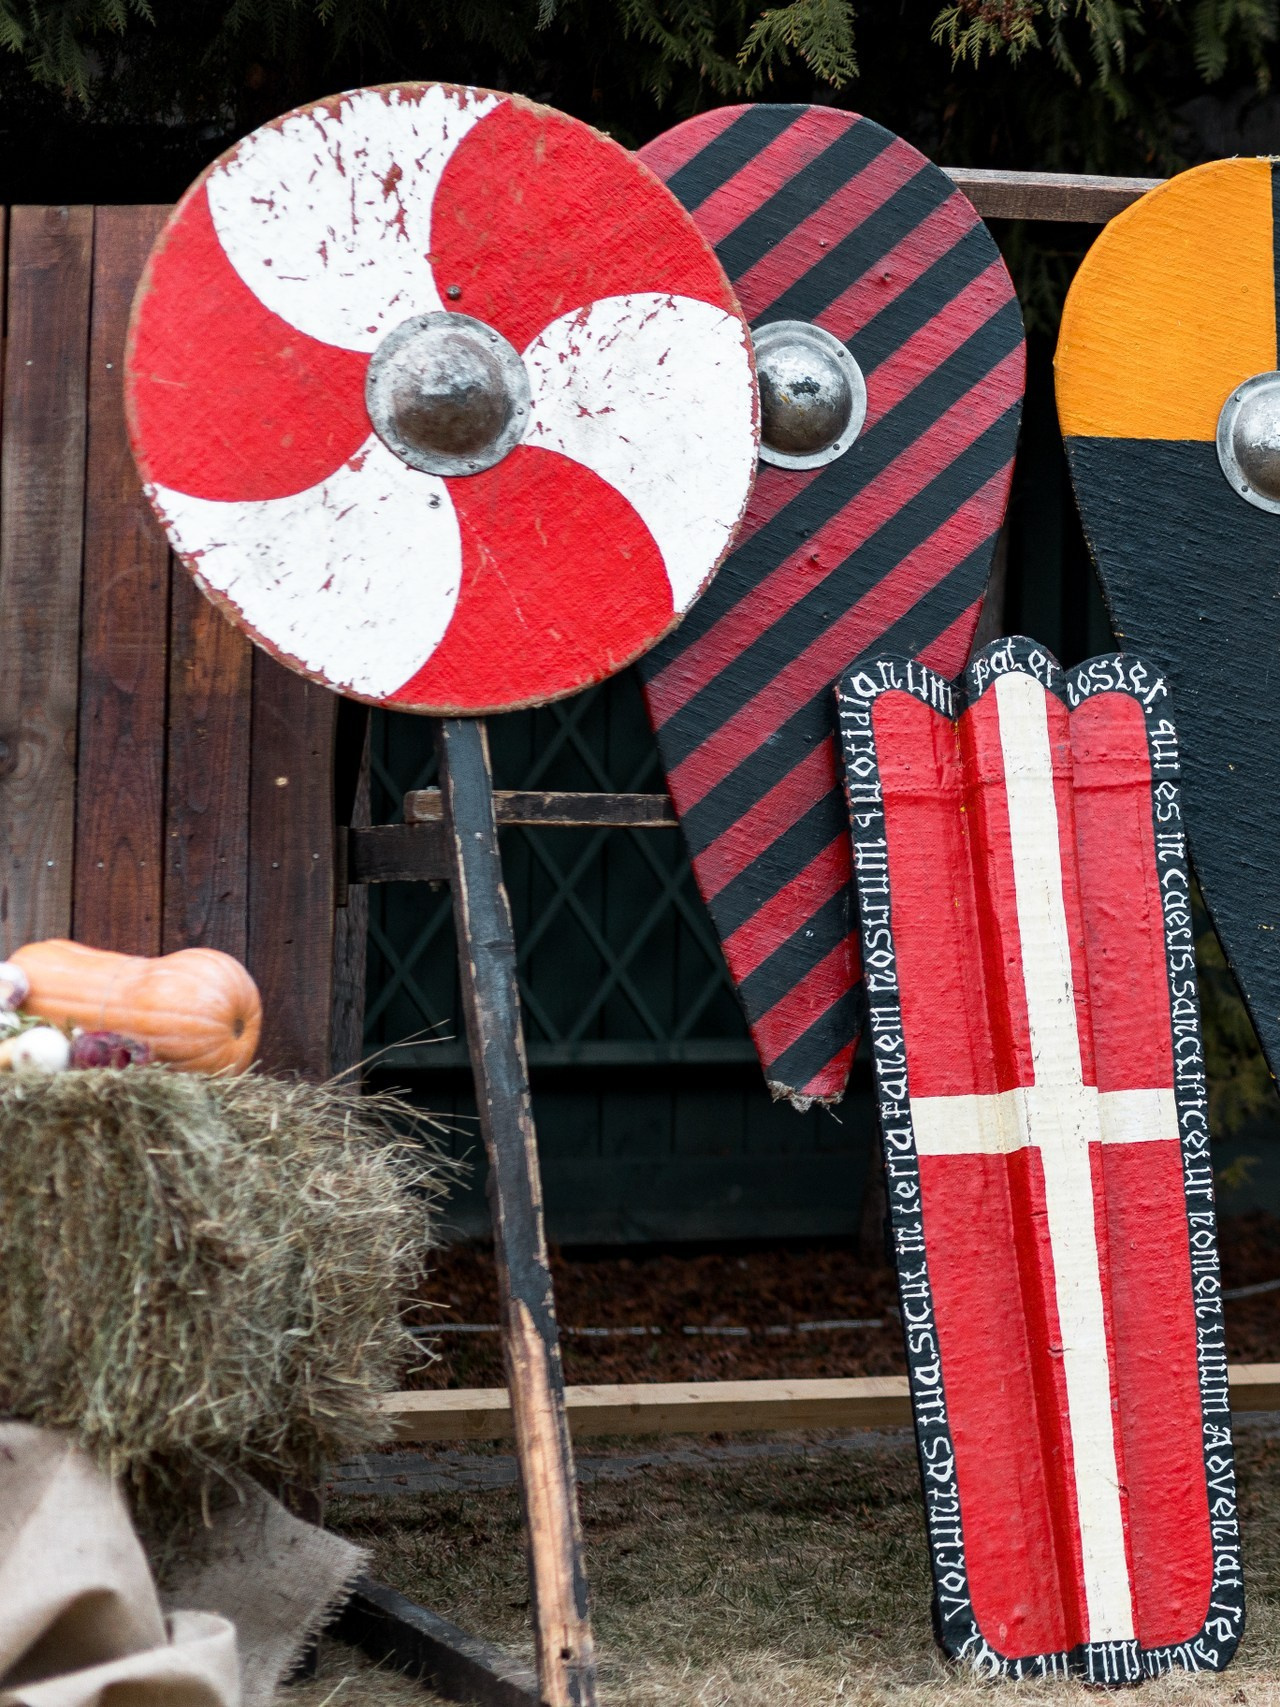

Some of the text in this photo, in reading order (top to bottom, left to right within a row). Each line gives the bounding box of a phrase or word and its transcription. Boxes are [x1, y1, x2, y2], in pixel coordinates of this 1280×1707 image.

[1148, 718, 1180, 770] qui
[1154, 781, 1181, 822] es
[1157, 832, 1184, 862] in
[855, 838, 897, 992] nostrum
[897, 1222, 925, 1254] in
[1190, 1211, 1222, 1318] nomen
